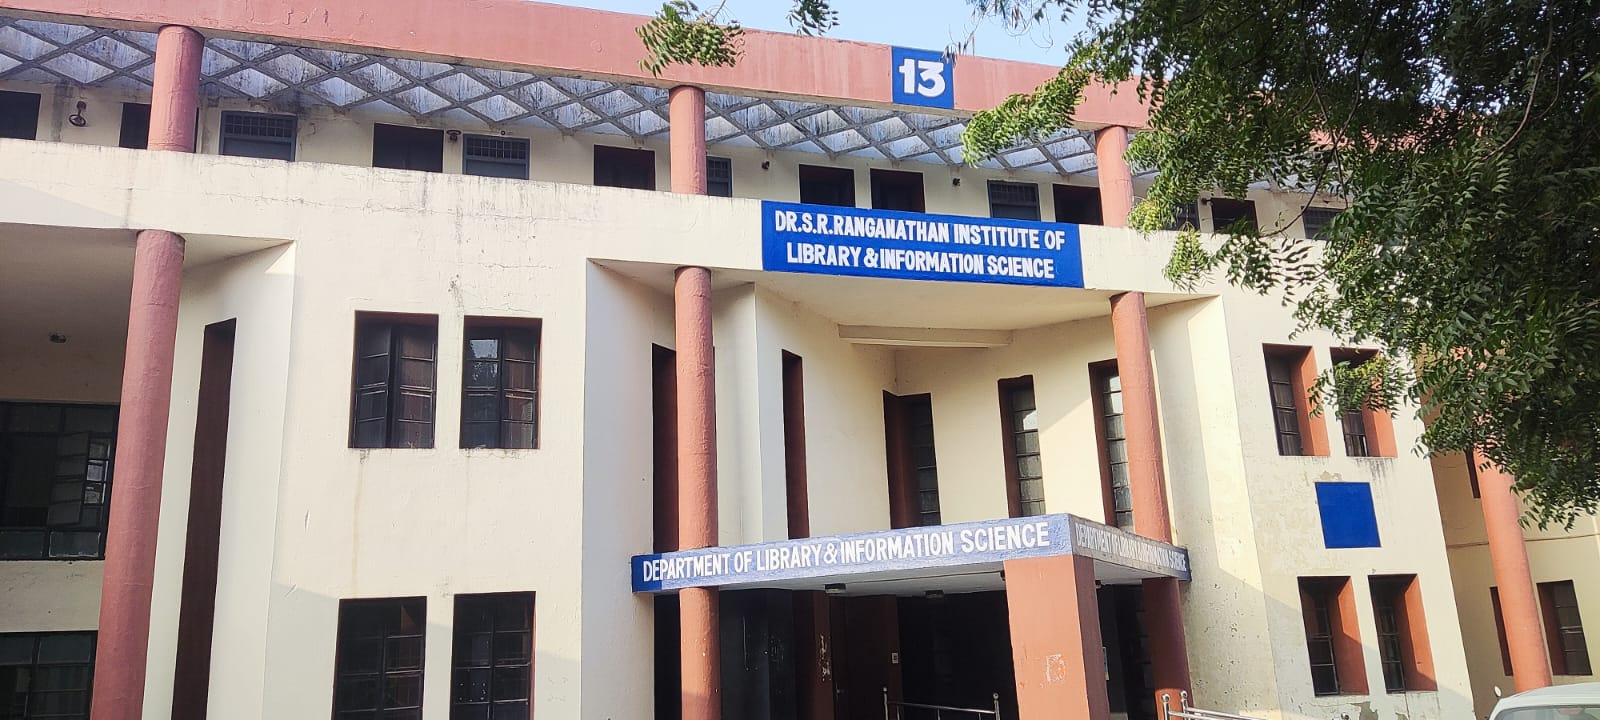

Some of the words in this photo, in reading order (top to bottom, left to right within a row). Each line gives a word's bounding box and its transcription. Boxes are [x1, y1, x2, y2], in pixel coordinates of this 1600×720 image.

[899, 58, 946, 97] 13
[775, 210, 950, 243] DR.S.R.RANGANATHAN
[953, 223, 1040, 249] INSTITUTE
[1044, 230, 1065, 250] OF
[786, 242, 862, 267] LIBRARY
[880, 248, 984, 275] INFORMATION
[987, 255, 1055, 279] SCIENCE
[643, 553, 730, 582] DEPARTMENT
[734, 551, 754, 573] OF
[756, 543, 823, 572] LIBRARY
[841, 530, 955, 564] INFORMATION
[959, 521, 1050, 552] SCIENCE
